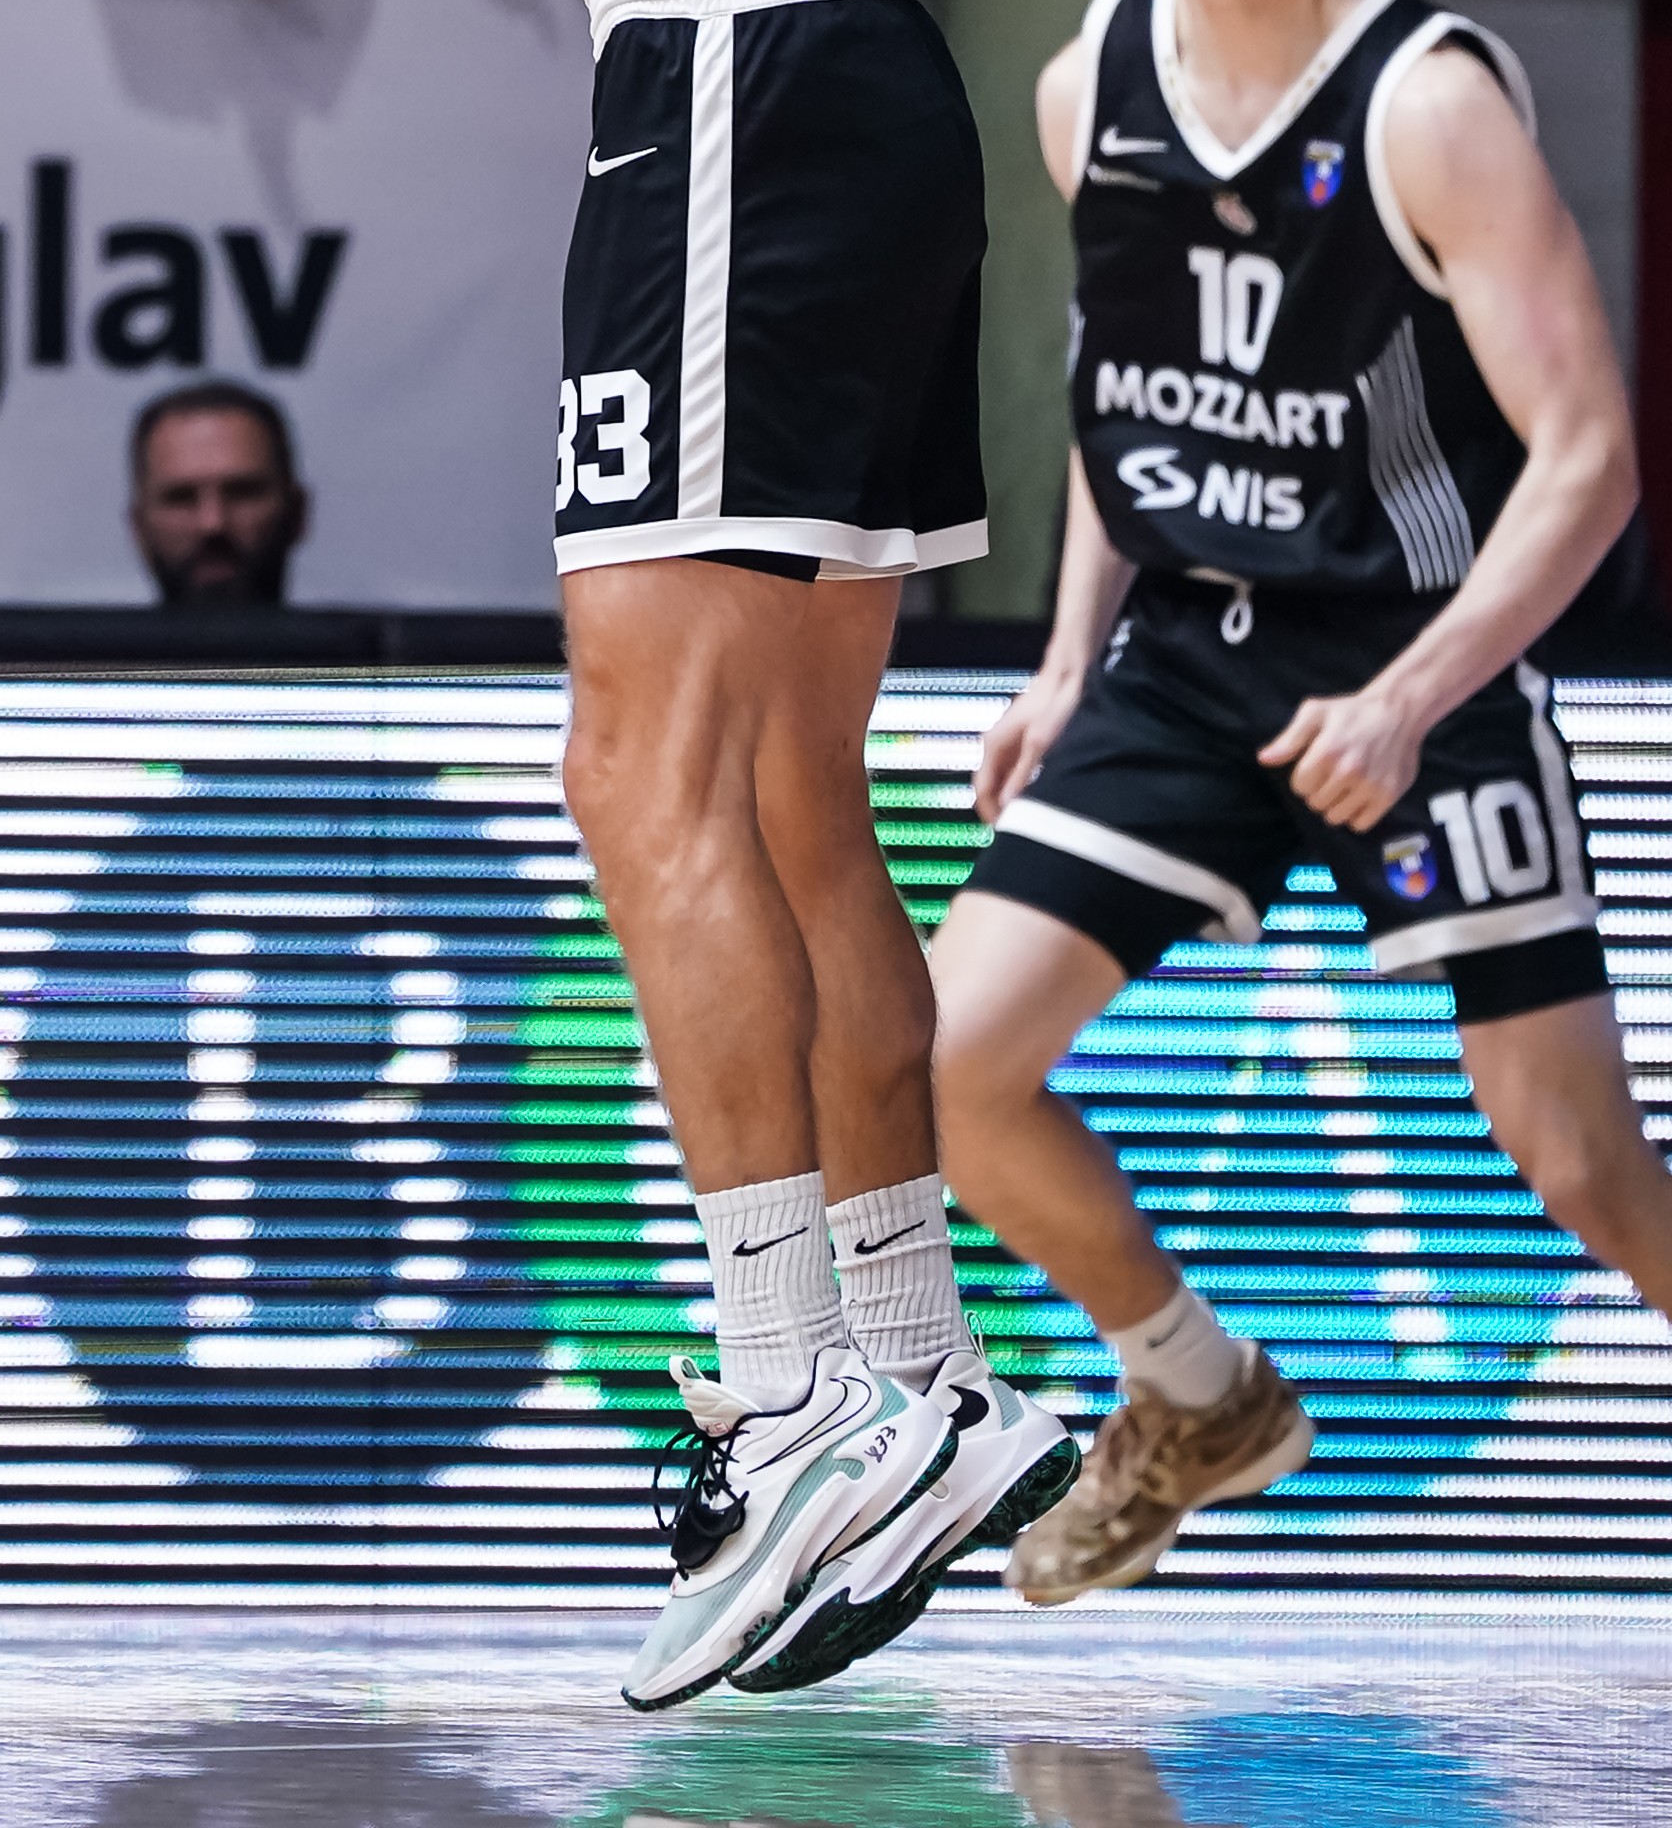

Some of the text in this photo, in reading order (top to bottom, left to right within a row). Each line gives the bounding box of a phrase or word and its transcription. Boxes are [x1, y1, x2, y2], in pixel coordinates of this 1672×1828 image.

[1187, 245, 1284, 375] 10
[1095, 360, 1351, 450] MOZZART
[1198, 463, 1306, 532] NIS
[1428, 779, 1552, 906] 10
